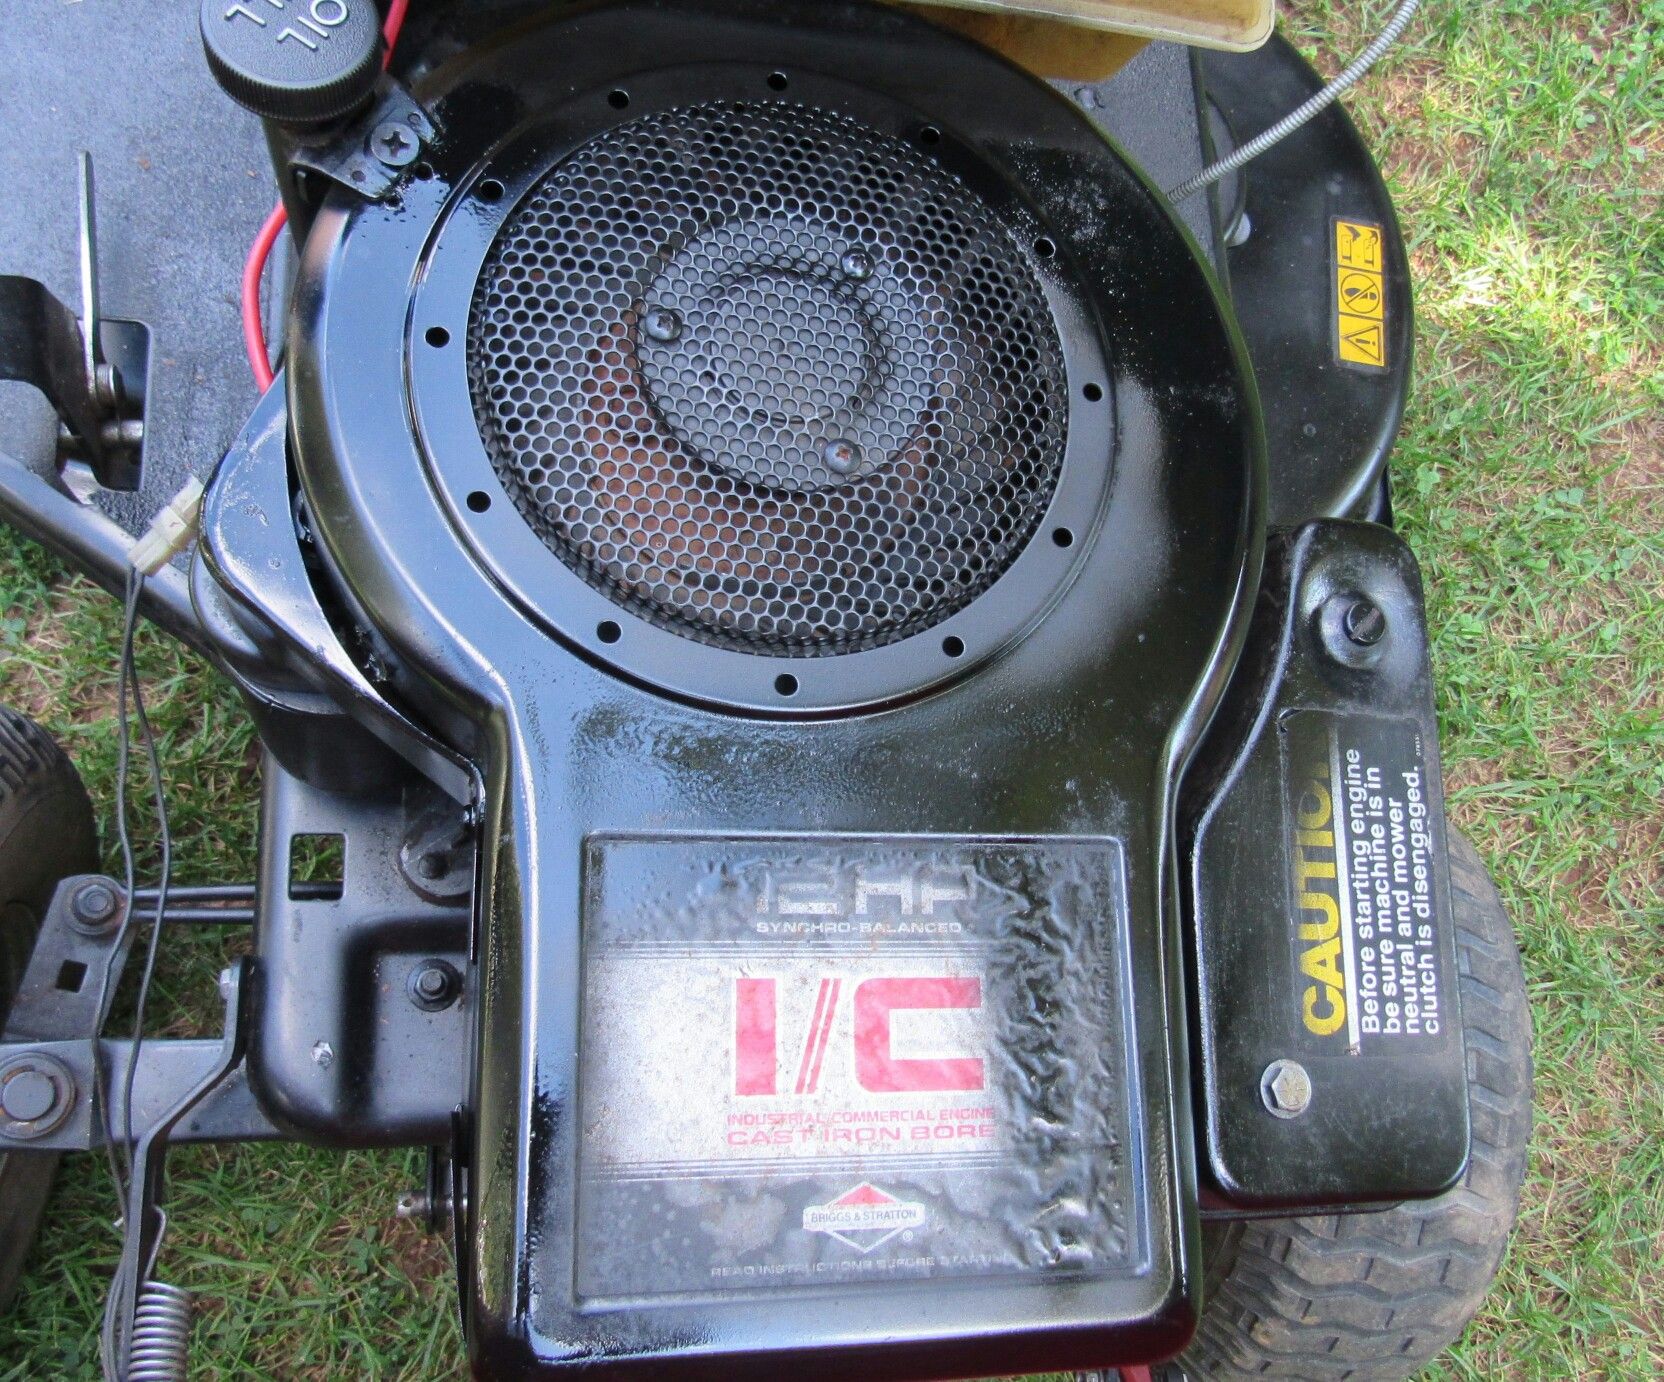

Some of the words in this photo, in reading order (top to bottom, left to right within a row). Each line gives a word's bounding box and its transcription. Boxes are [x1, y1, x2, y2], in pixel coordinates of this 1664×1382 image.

[276, 0, 348, 49] OIL
[1344, 748, 1367, 834] engine
[1364, 767, 1381, 789] in
[1366, 796, 1384, 817] is
[1389, 797, 1408, 883] mower
[1402, 765, 1430, 918] disengaged.
[1350, 840, 1373, 939] starting
[1370, 823, 1393, 932] machine
[755, 921, 963, 934] SYNCHRO-BALANCED
[1391, 889, 1412, 937] and
[1415, 924, 1432, 946] is
[1359, 946, 1380, 1033] Before
[1379, 938, 1398, 997] sure
[1396, 944, 1420, 1034] neutral
[1383, 1001, 1401, 1034] be
[1417, 953, 1439, 1035] clutch
[727, 1128, 815, 1146] CAST
[823, 1126, 900, 1143] IRON
[910, 1124, 996, 1140] BORE
[939, 1107, 996, 1121] ENGINE
[810, 1212, 852, 1224] BRIGGS
[854, 1211, 861, 1222] &
[863, 1209, 917, 1222] STRATTON
